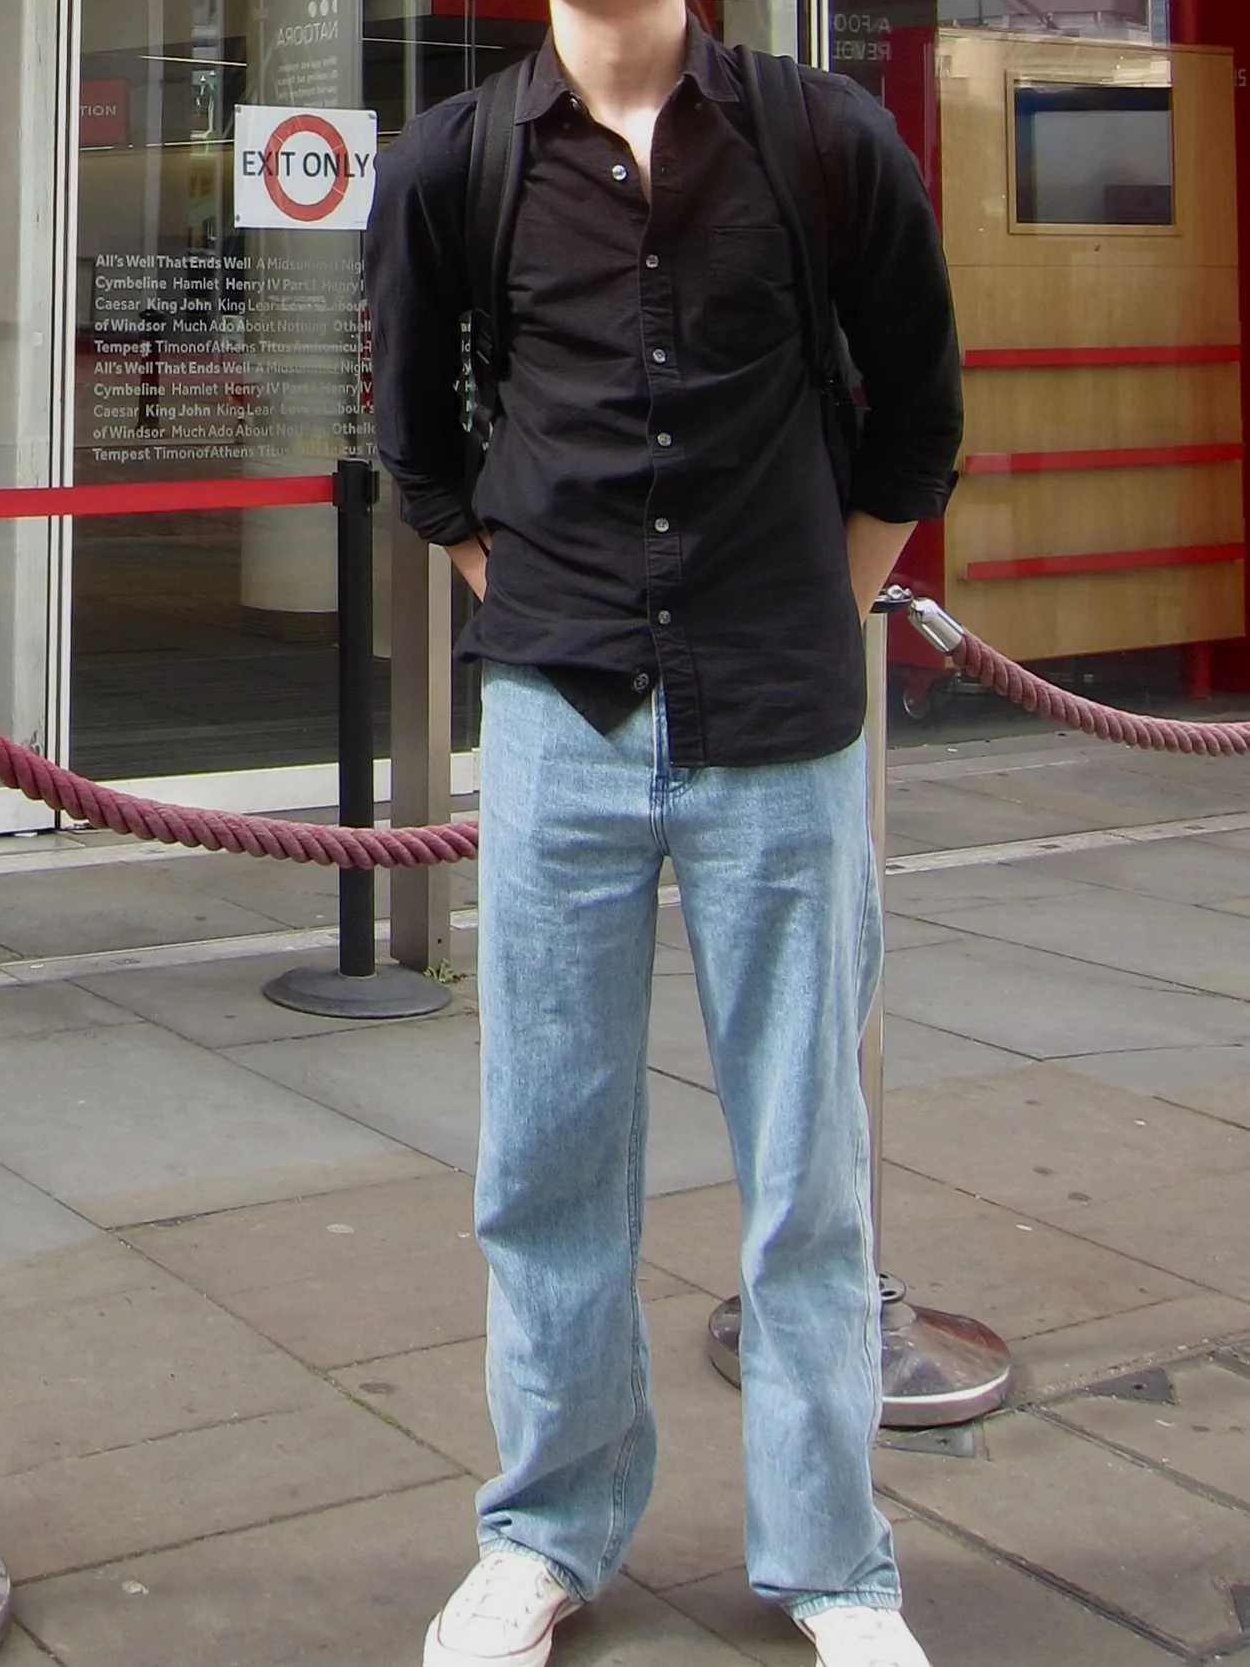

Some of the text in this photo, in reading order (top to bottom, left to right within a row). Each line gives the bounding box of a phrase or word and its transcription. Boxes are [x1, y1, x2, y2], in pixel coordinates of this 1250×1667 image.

[243, 150, 370, 178] EXIT ONLY
[95, 254, 124, 268] All's
[126, 255, 155, 268] Well
[156, 256, 188, 269] That
[190, 256, 221, 269] Ends
[223, 256, 251, 270] Well
[256, 258, 266, 270] A
[95, 275, 167, 292] Cymbeline
[173, 277, 220, 290] Hamlet
[225, 277, 265, 293] Henry
[266, 278, 281, 291] IV
[94, 296, 141, 310] Caesar
[147, 298, 178, 314] King
[180, 298, 213, 311] John
[218, 298, 246, 314] King
[248, 298, 277, 312] Lear
[94, 318, 110, 332] of
[111, 318, 167, 332] Windsor
[173, 319, 208, 332] Much
[210, 319, 234, 332] Ado
[236, 320, 276, 332] About
[277, 321, 327, 335] Nothing
[94, 339, 153, 356] Tempest
[94, 361, 123, 374] All's
[125, 361, 153, 374] Well
[155, 361, 187, 374] That
[189, 361, 220, 374] Ends
[222, 361, 250, 374] Well
[93, 383, 166, 399] Cymbeline
[171, 382, 218, 395] Hamlet
[225, 382, 264, 397] Henry
[266, 381, 280, 394] IV
[93, 404, 139, 418] Caesar
[145, 404, 176, 420] King
[178, 403, 210, 417] John
[217, 403, 245, 419] King
[247, 403, 275, 416] Lear
[92, 426, 109, 439] of
[110, 425, 166, 439] Windsor
[171, 425, 206, 438] Much
[209, 425, 233, 437] Ado
[235, 424, 275, 437] About
[92, 447, 151, 464] Tempest
